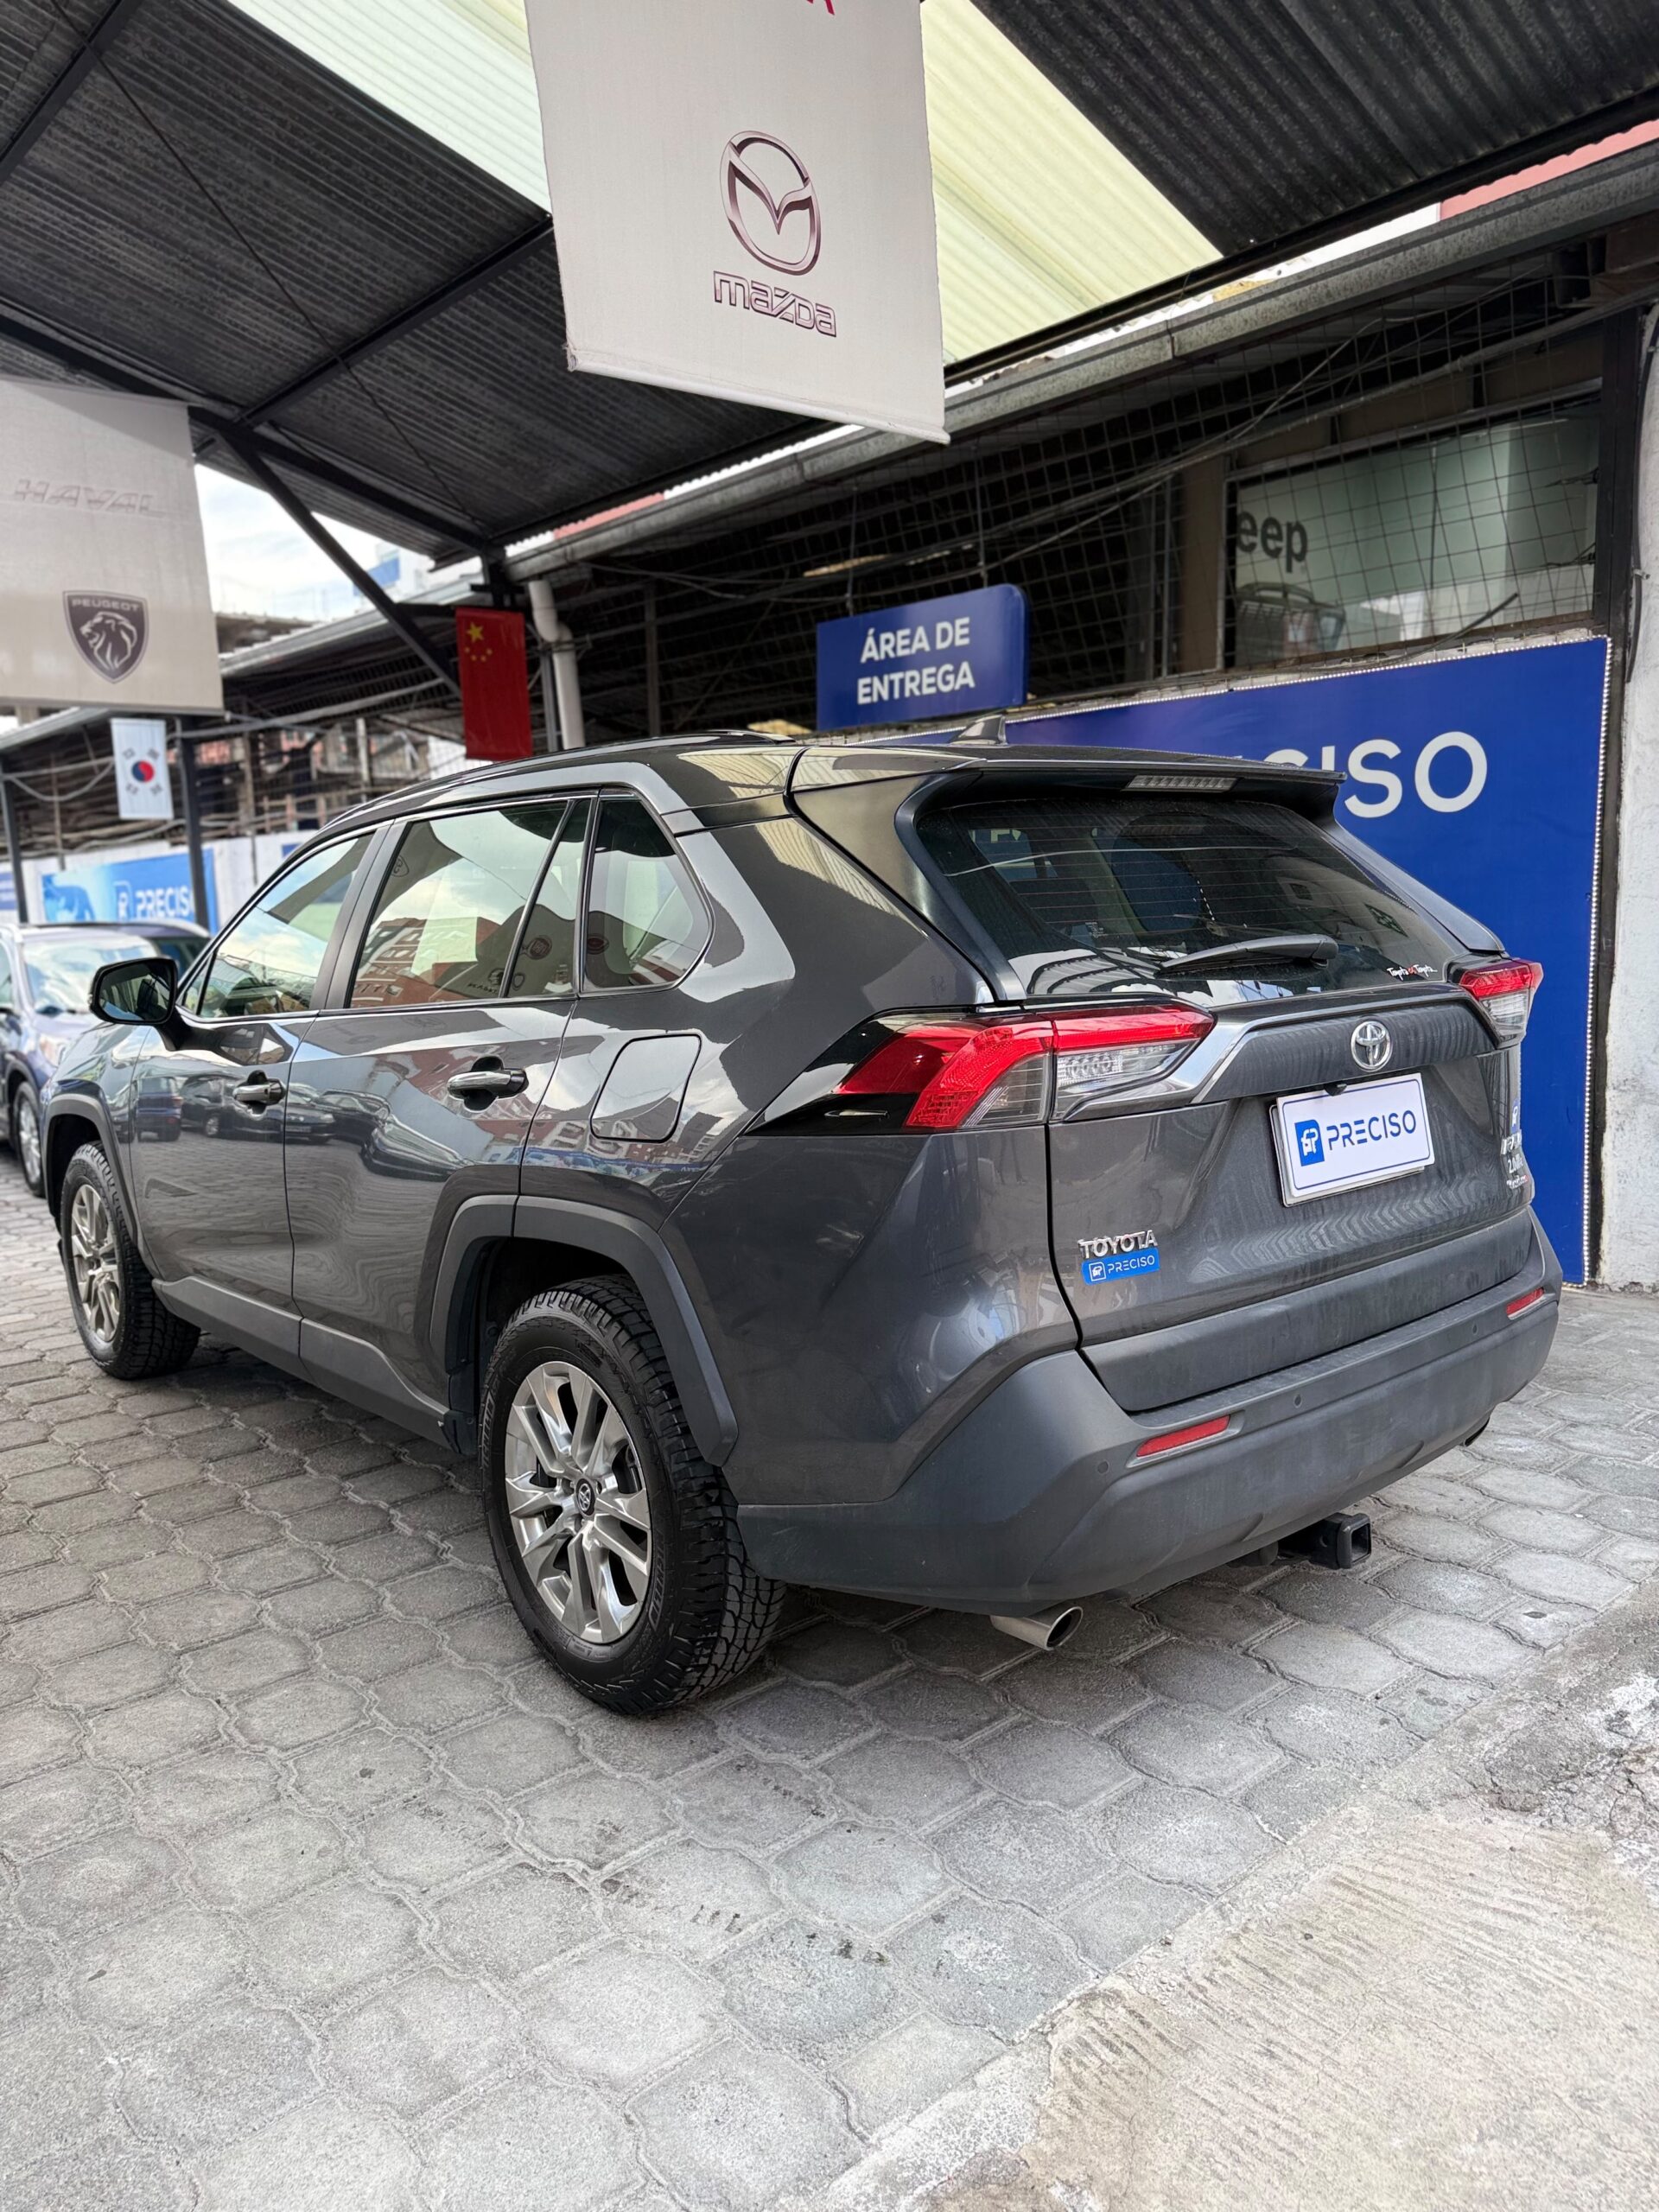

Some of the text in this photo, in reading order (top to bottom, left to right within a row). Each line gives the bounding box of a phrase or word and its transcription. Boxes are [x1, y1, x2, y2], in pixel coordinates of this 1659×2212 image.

[1236, 511, 1308, 575] eep
[72, 598, 139, 612] PEUGEOT
[860, 617, 970, 664] ÁREA DE
[857, 661, 976, 705] ENTREGA
[135, 885, 194, 919] PRECIS
[1325, 1109, 1417, 1151] PRECISO
[1077, 1230, 1159, 1259] TOYOTA
[1107, 1255, 1155, 1274] PRECISO
